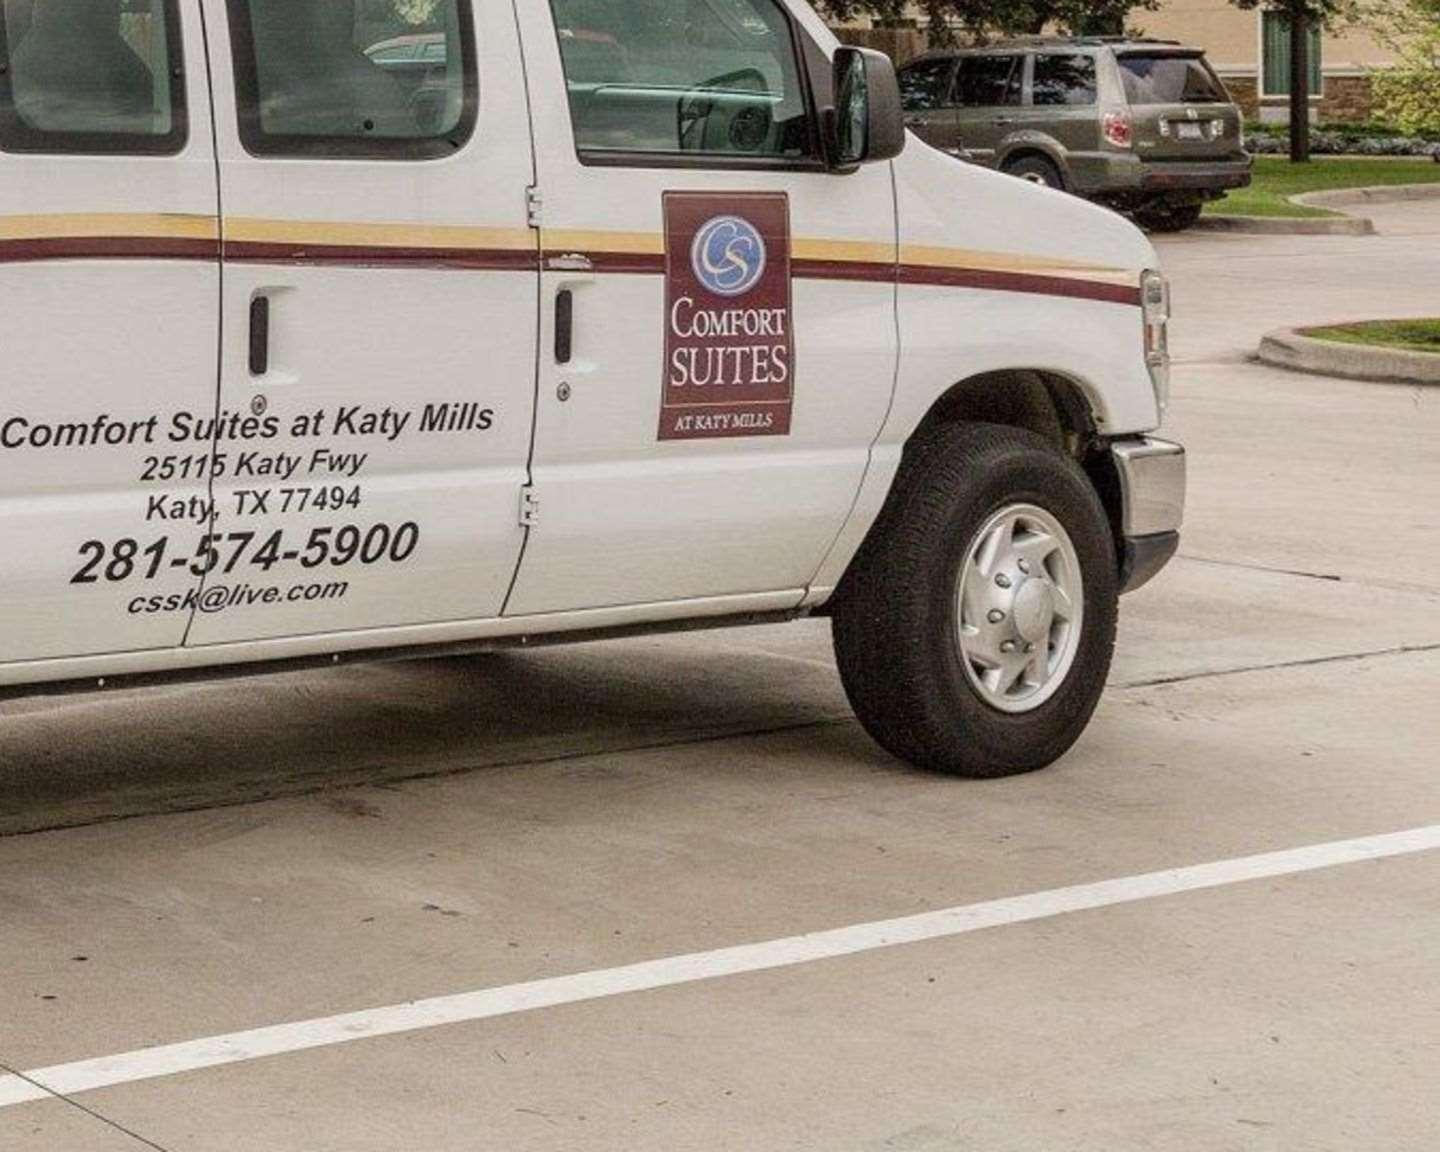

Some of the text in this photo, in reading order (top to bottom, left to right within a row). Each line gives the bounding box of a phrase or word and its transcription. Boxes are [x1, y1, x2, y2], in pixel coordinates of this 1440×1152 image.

[671, 298, 786, 338] COMFORT
[670, 346, 788, 386] SUITES
[0, 403, 494, 448] Comfort Suites at Katy Mills
[674, 413, 773, 431] AT KATY MILLS
[140, 449, 368, 481] 25115 Katy Fwy
[146, 486, 361, 524] Katy, TX 77494
[70, 522, 420, 584] 281-574-5900
[128, 580, 349, 614] cssk@live.com
